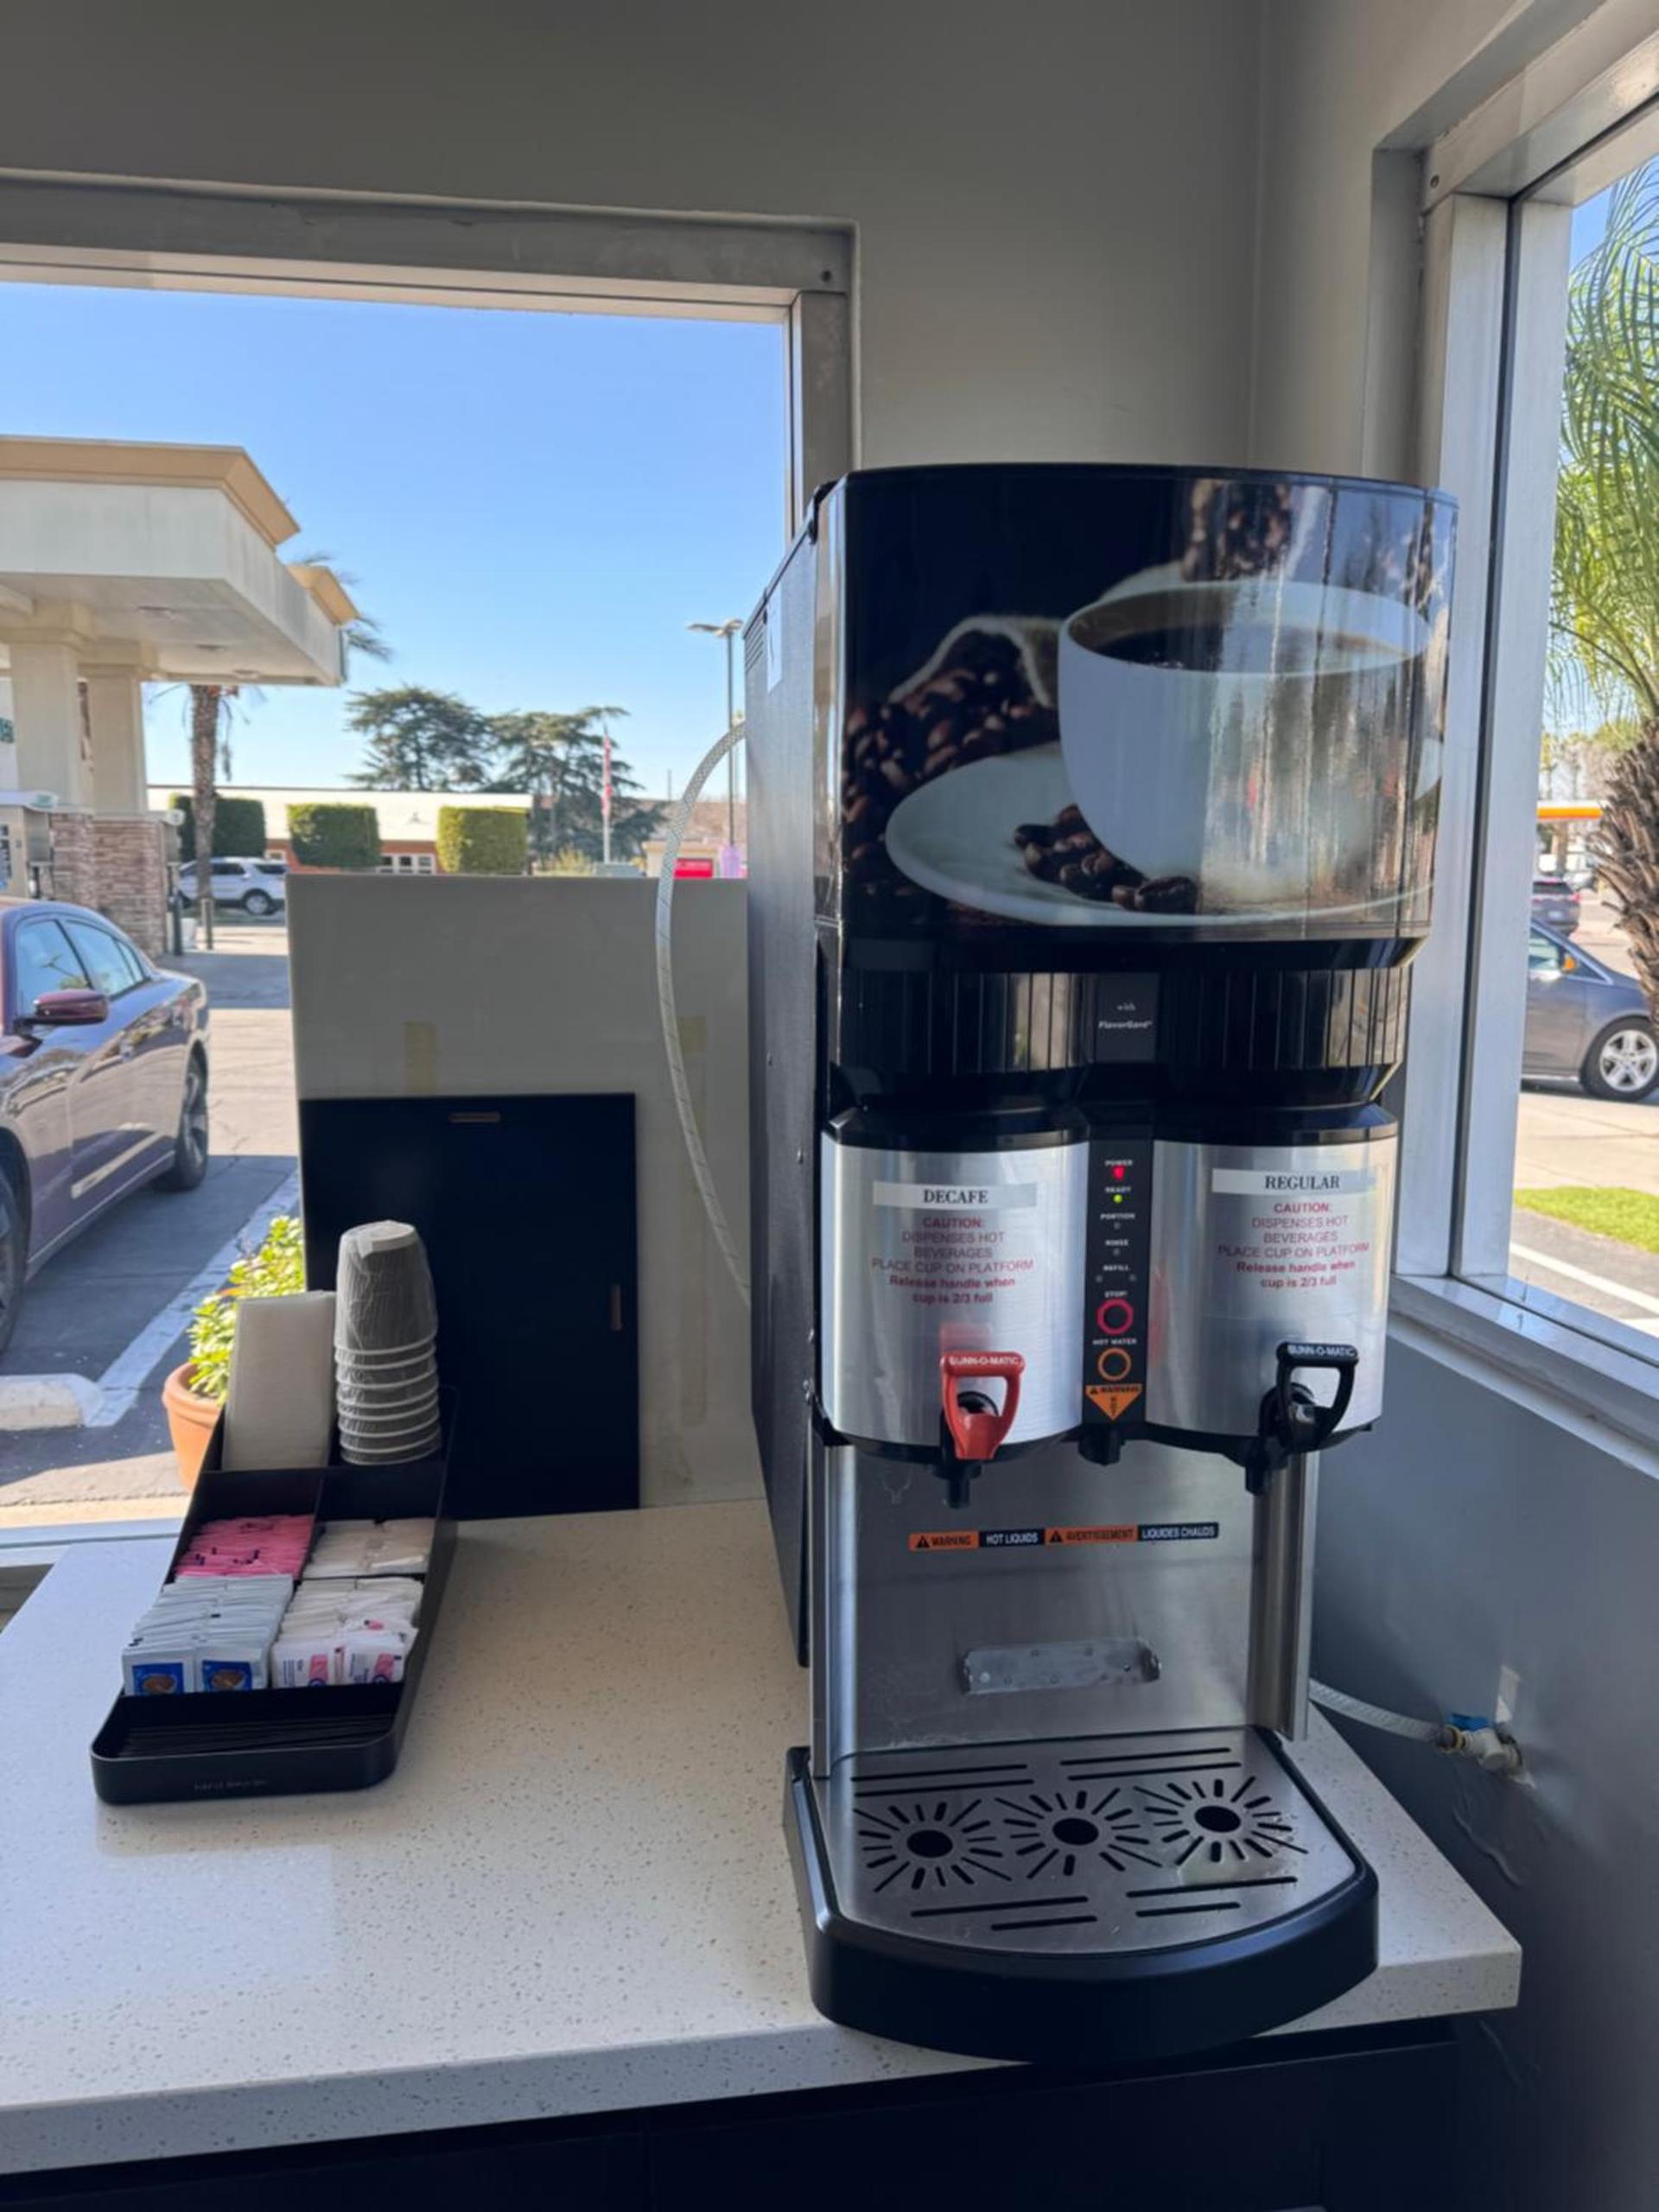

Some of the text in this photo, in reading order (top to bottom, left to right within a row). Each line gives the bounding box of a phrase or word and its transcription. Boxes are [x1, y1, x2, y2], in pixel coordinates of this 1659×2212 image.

[1265, 1175, 1340, 1190] REGULAR
[923, 1189, 988, 1204] DECAFE
[1252, 1215, 1349, 1228] DISPENSES HOT
[901, 1230, 1005, 1243] DISPENSES HOT
[1263, 1231, 1338, 1243] BEVERAGES
[913, 1246, 993, 1259] BEVERAGES
[1217, 1242, 1369, 1258] PLACE CUP ON PLATFORM
[872, 1257, 1033, 1274] PLACE CUP ON PLATFORM
[1236, 1260, 1356, 1274] Release handle when
[889, 1274, 1016, 1289] Release handle when
[1261, 1274, 1338, 1290] cup is 2/3 full
[912, 1292, 993, 1306] cup is 2/3 full
[931, 1535, 971, 1547] WARNING
[986, 1533, 1003, 1545] HOT
[1005, 1532, 1039, 1544] LIQUIDS
[1141, 1527, 1179, 1539] LIQUIDES
